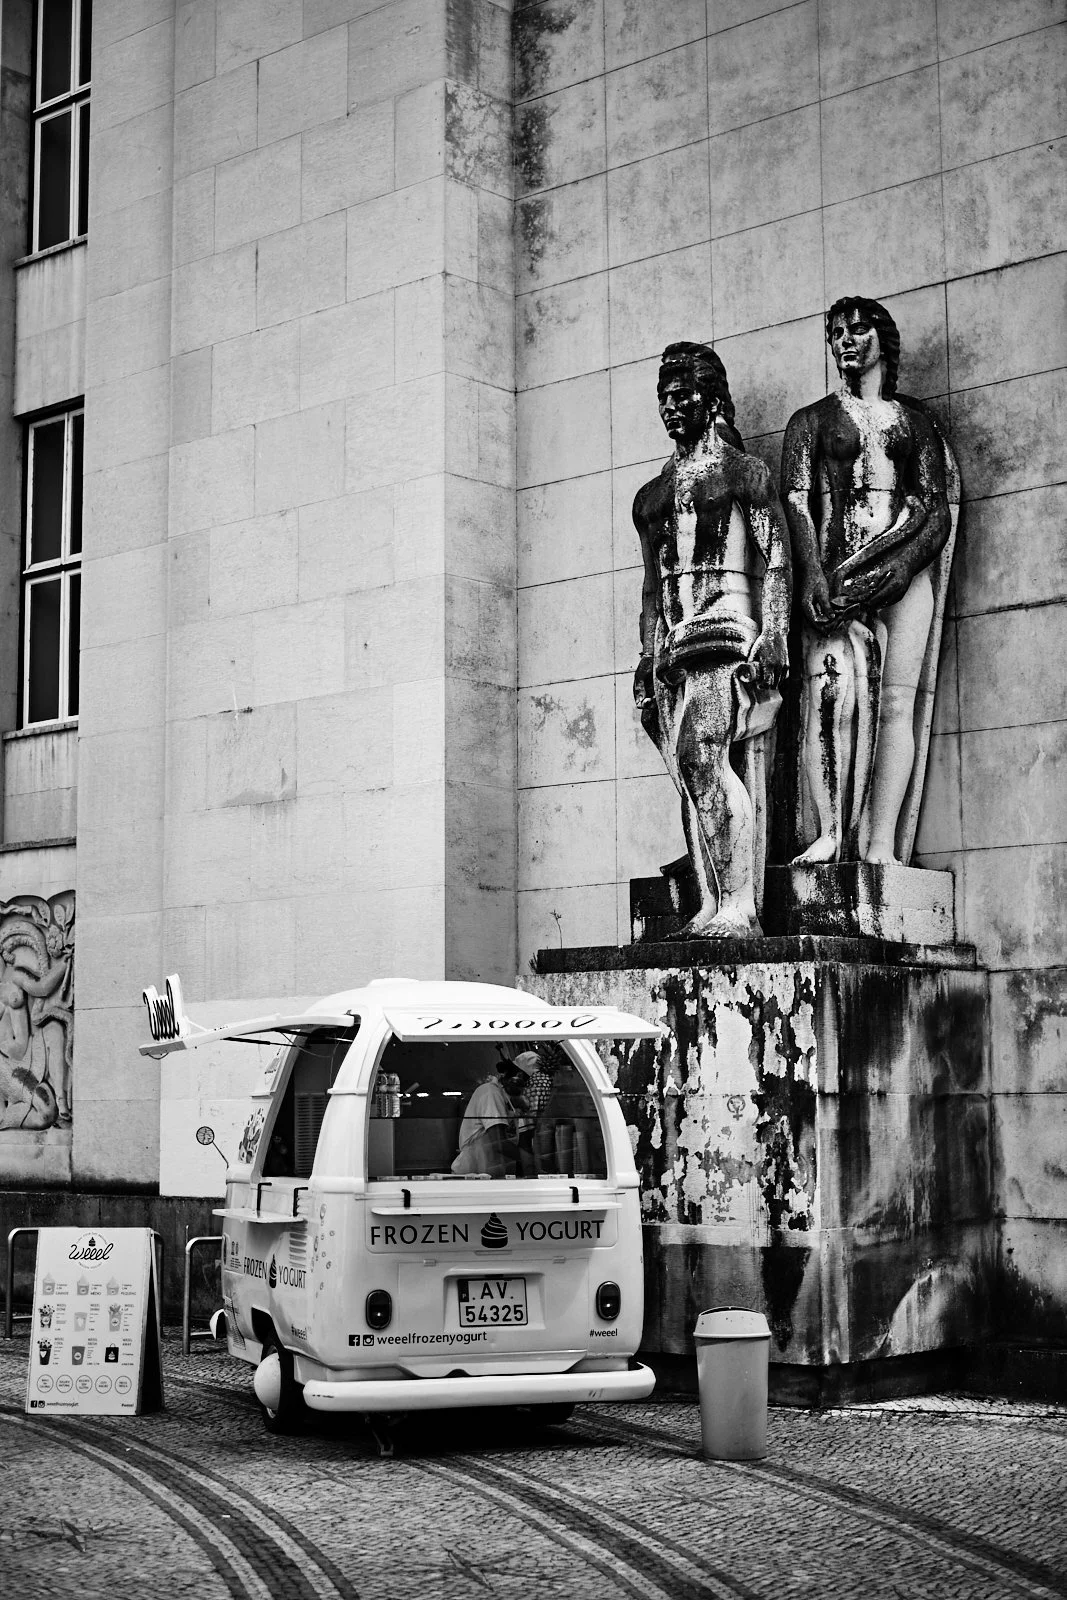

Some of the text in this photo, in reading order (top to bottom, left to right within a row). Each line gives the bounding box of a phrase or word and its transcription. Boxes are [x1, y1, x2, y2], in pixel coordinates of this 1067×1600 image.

[370, 1219, 605, 1246] FROZEN YOGURT
[243, 1256, 307, 1289] FROZEN YOGURT
[465, 1304, 524, 1323] 54325
[377, 1331, 488, 1346] weeelfrozenyogurt
[589, 1328, 618, 1338] #weeel
